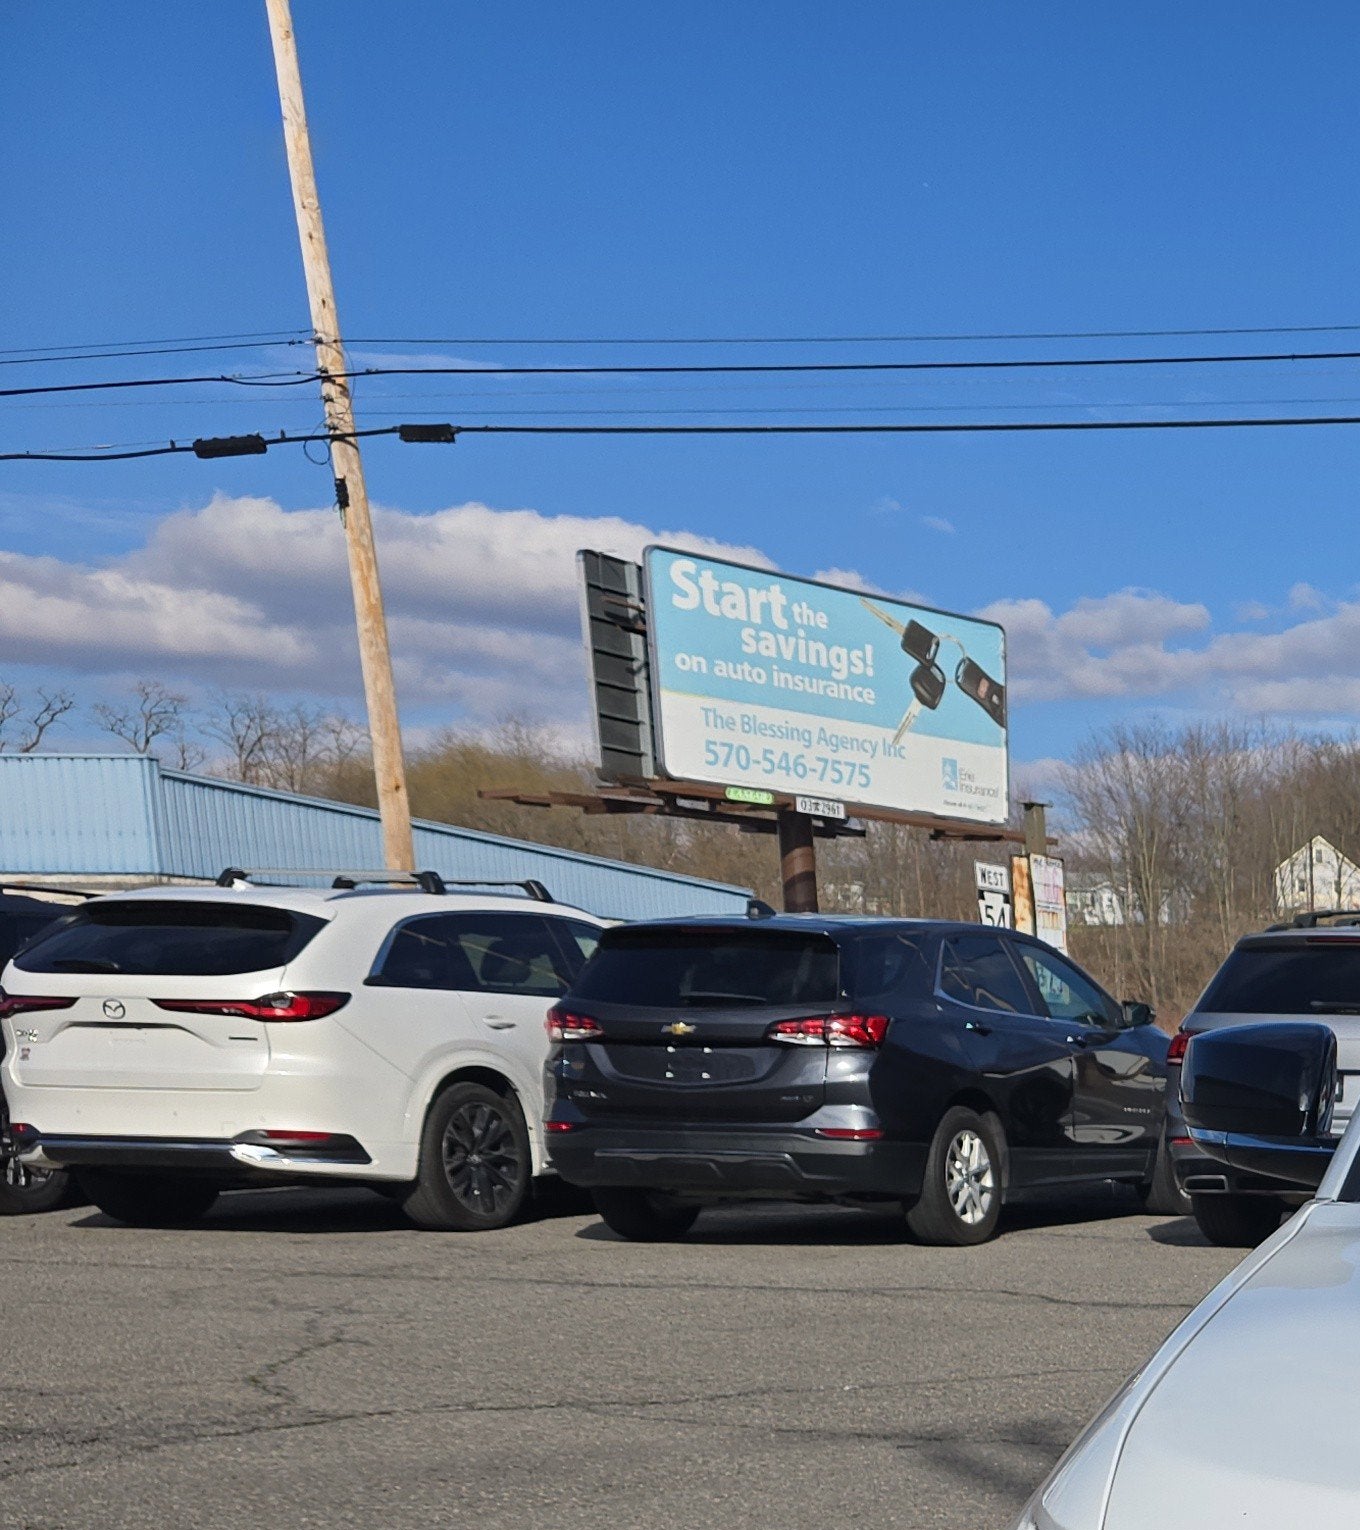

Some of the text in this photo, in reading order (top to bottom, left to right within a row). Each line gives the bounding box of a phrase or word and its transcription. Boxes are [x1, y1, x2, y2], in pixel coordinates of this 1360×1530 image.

[670, 559, 828, 629] Start the
[674, 653, 876, 705] on auto insurance
[741, 627, 874, 680] savings!
[701, 706, 906, 760] The Blessing Agency Inc
[705, 739, 871, 788] 570-546-7575
[979, 866, 1004, 887] WEST
